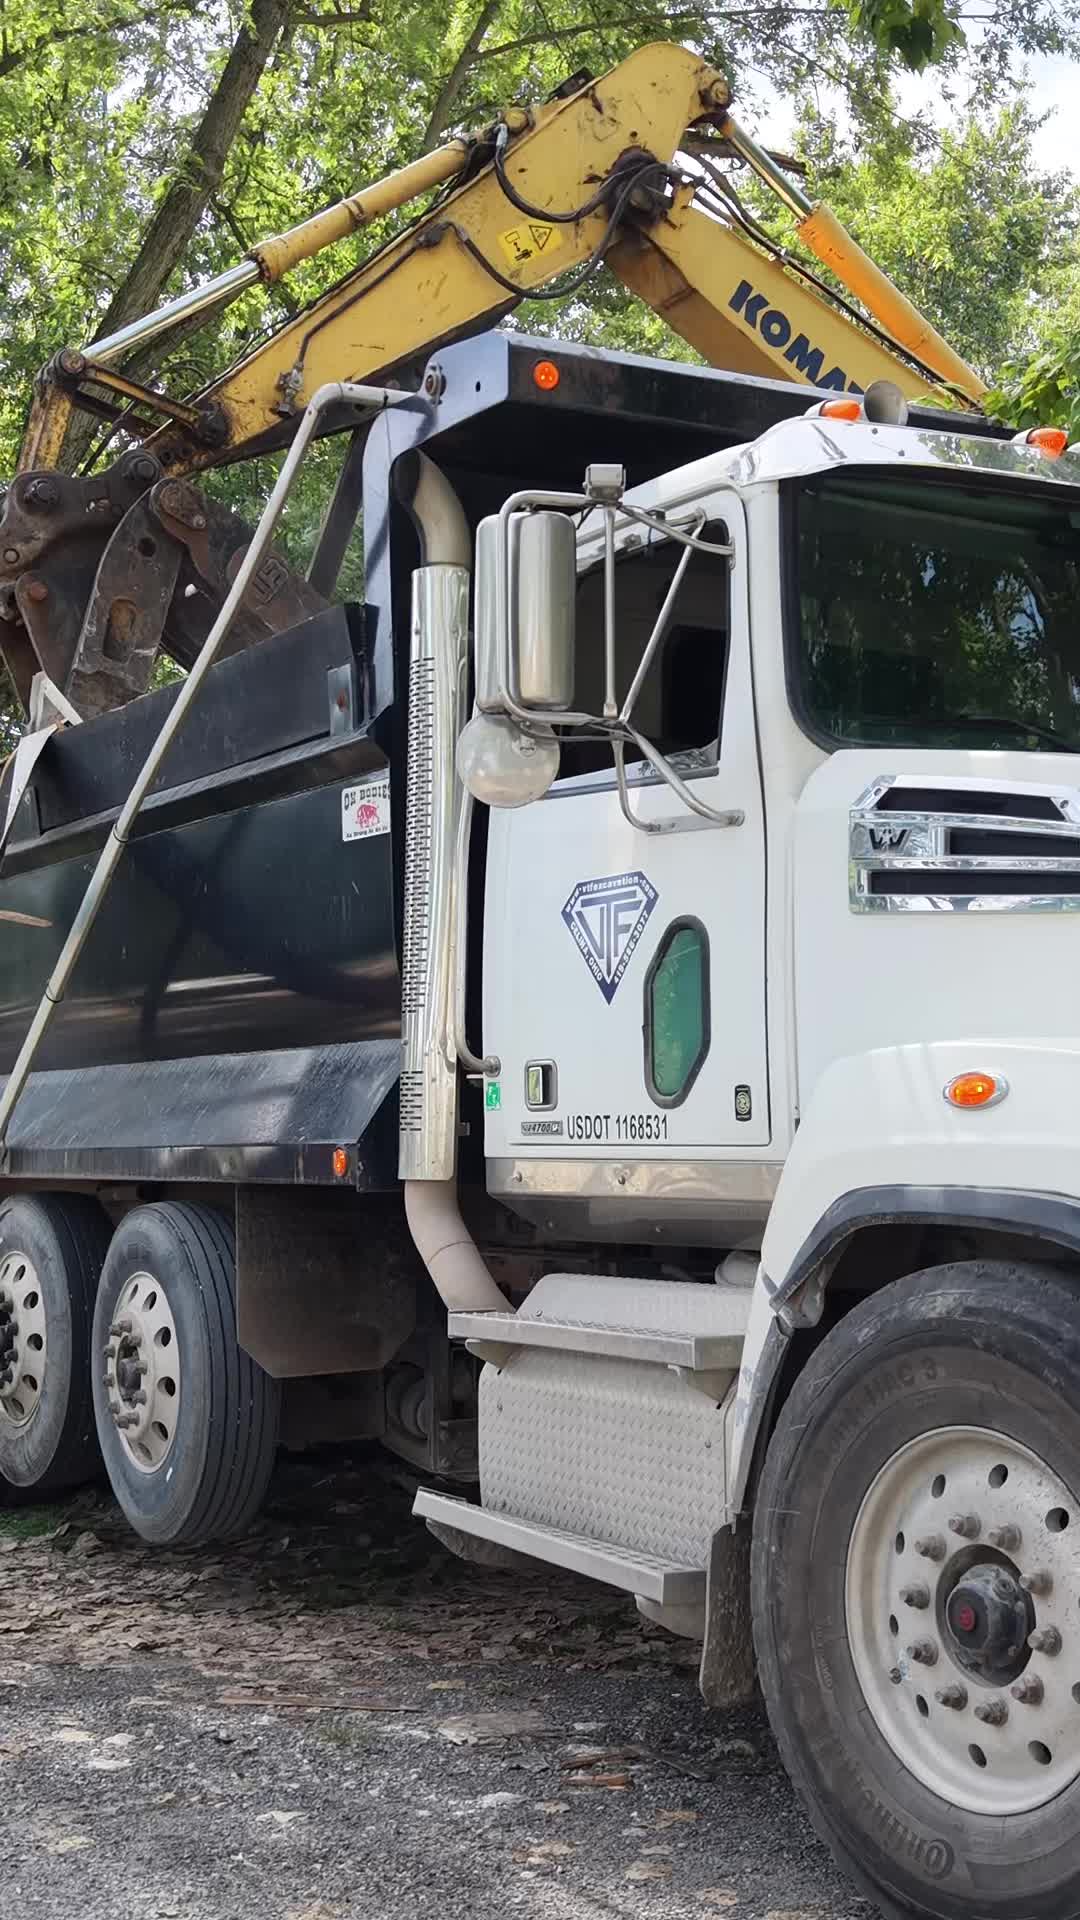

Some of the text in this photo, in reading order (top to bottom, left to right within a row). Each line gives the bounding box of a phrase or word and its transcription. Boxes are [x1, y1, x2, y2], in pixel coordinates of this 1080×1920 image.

[728, 279, 865, 394] KOMA
[567, 1115, 610, 1139] USDOT
[616, 1114, 668, 1139] 1168531
